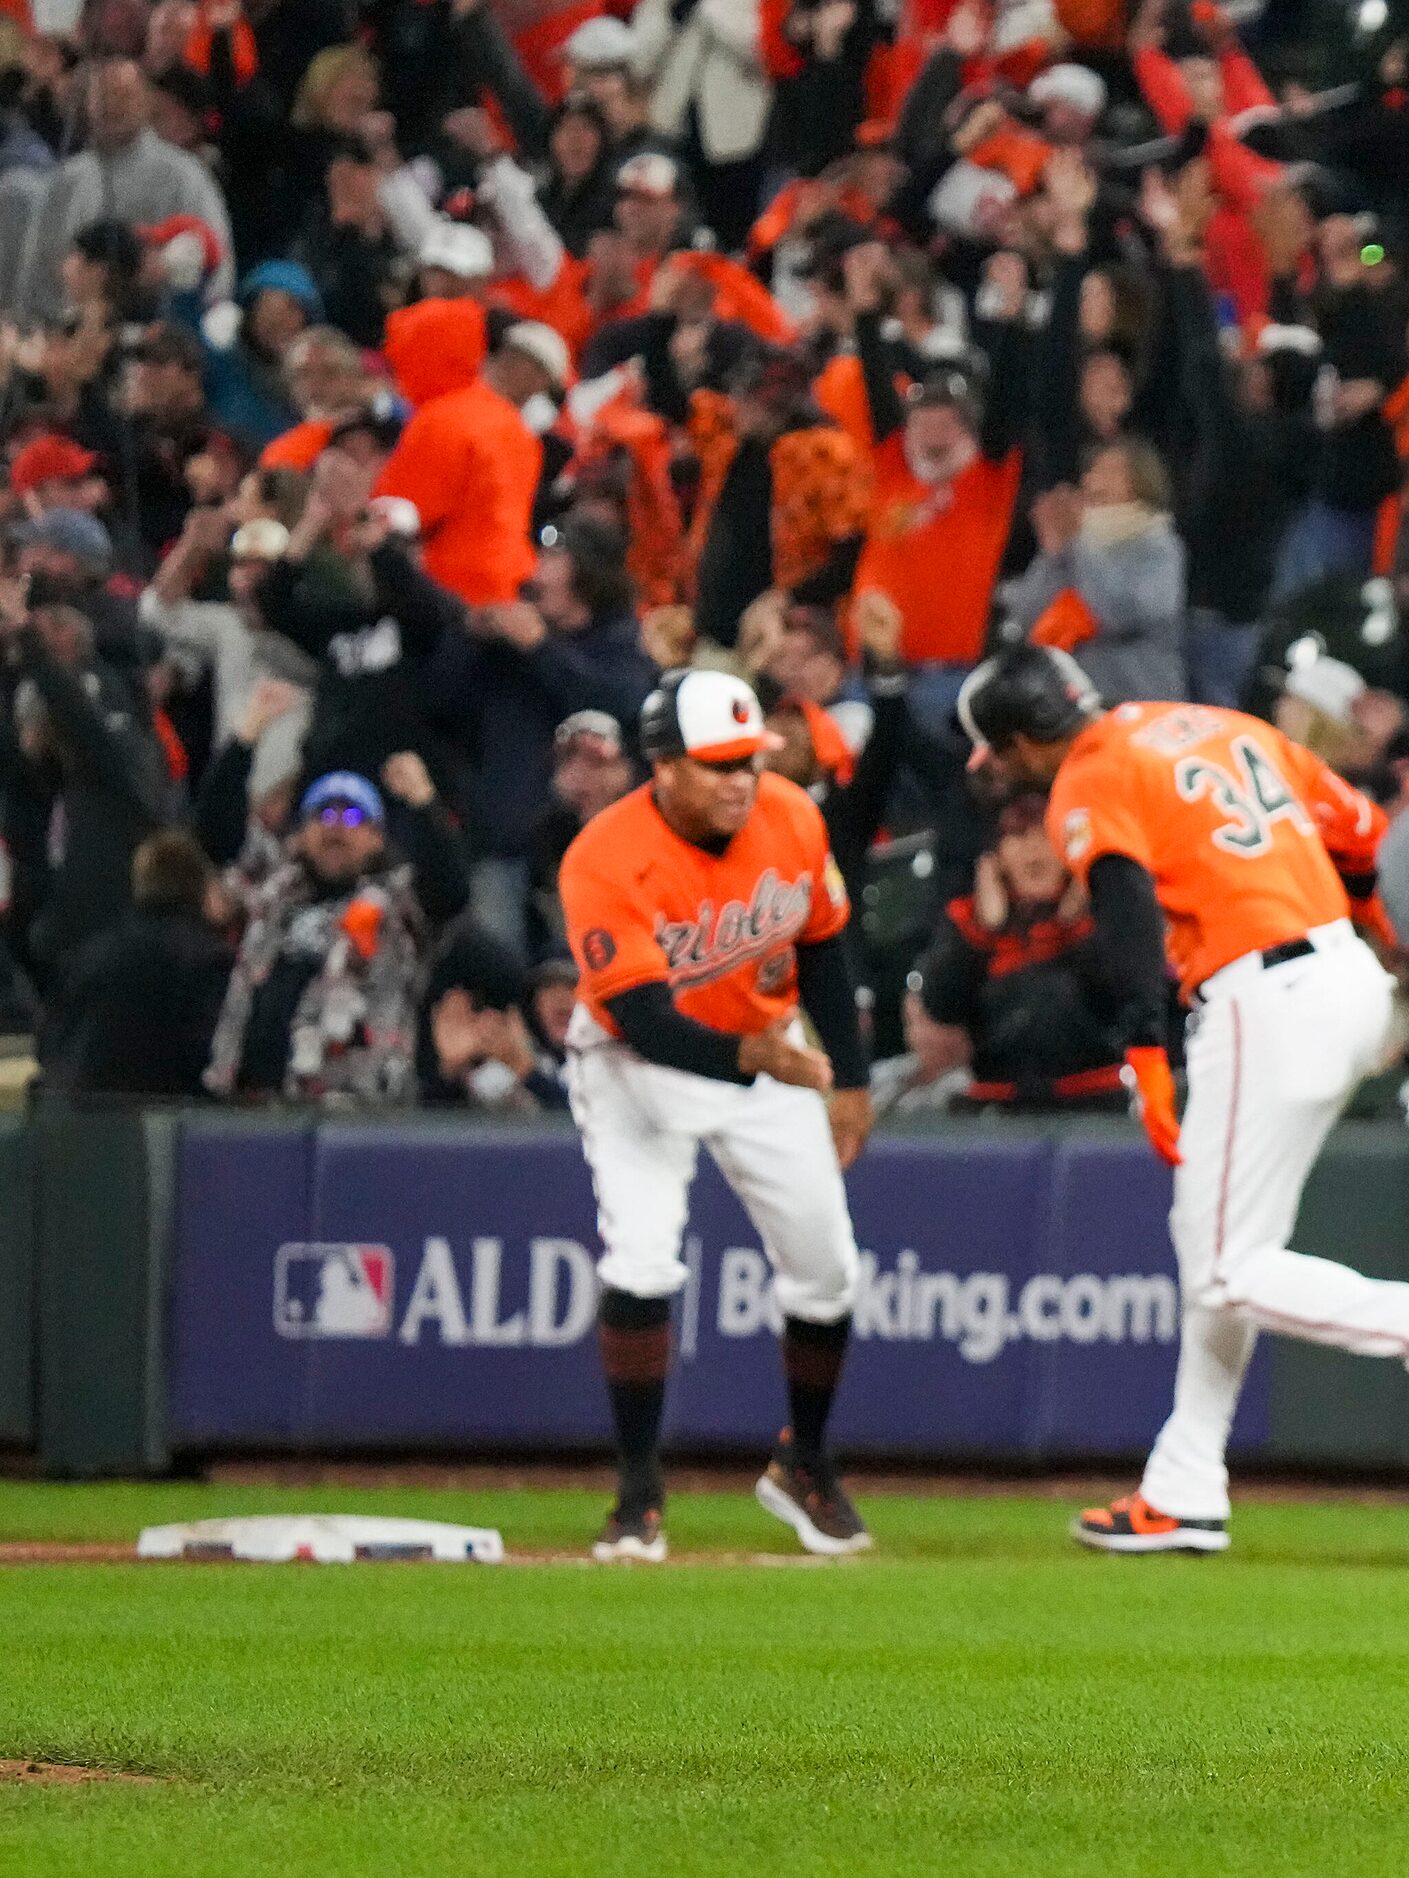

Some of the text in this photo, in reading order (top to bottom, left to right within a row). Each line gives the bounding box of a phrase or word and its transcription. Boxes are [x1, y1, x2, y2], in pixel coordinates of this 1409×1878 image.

[1174, 734, 1315, 859] 34
[401, 1236, 1178, 1363] ALD Bking.com
